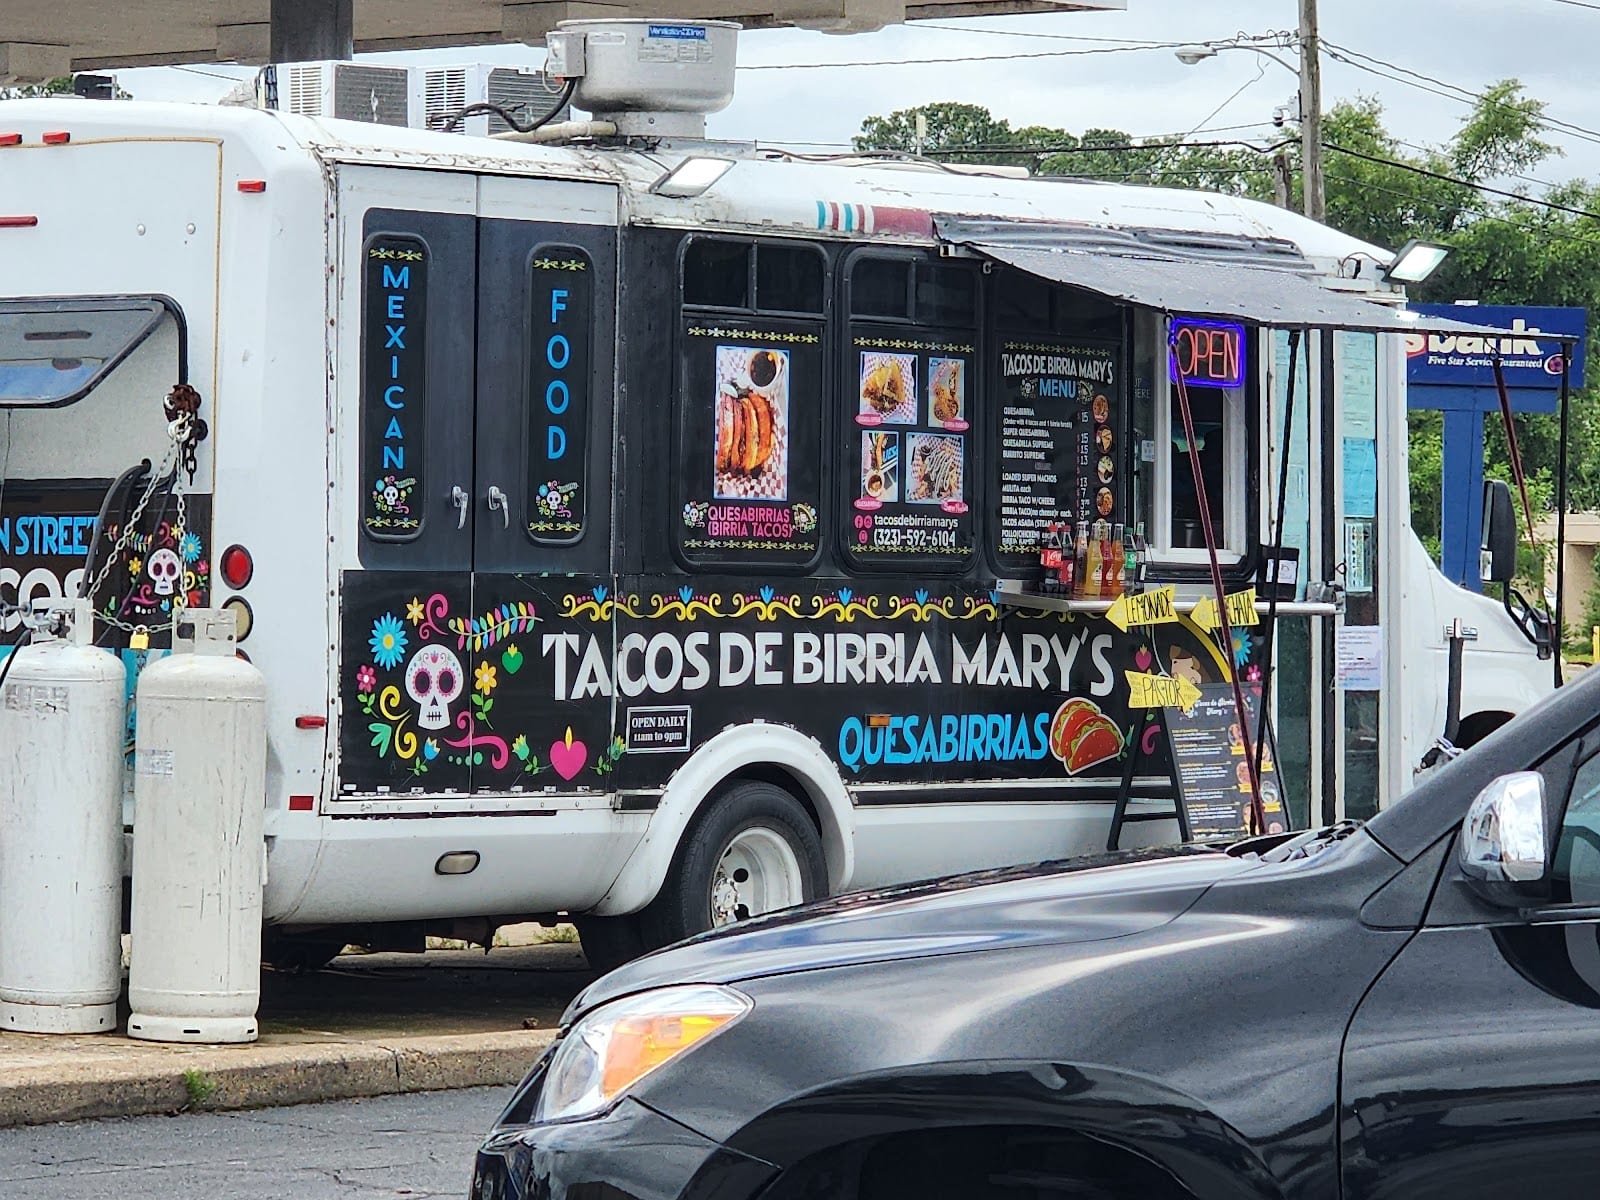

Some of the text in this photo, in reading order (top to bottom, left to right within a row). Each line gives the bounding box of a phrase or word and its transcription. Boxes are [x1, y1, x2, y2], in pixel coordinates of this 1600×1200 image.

[1177, 328, 1239, 379] OPEN
[1428, 356, 1446, 365] Five
[1447, 356, 1465, 366] Star
[382, 264, 409, 470] MEXICAN
[545, 289, 570, 460] FOOD
[1002, 354, 1113, 384] TACOS DE BIRRIA MARY'S
[1040, 378, 1076, 398] MENU
[1003, 439, 1031, 448] QUESADILLA
[1002, 473, 1057, 483] LOADED SUPER NACHOS
[1018, 496, 1031, 504] TACO
[708, 505, 790, 523] QUESABIRRIAS
[874, 514, 959, 530] tacosdebirriamarys
[1002, 518, 1017, 526] TACOS
[708, 521, 793, 538] (BIRRIA TACOS)
[874, 528, 956, 547] (323)-592-6104
[1126, 589, 1173, 624] LEMONADE
[1212, 592, 1256, 625] HCHATA
[542, 626, 1115, 701] TACOS DE BIRRIA MARY'S
[1142, 676, 1186, 707] PASTOR
[632, 716, 686, 728] OPEN DAILY
[634, 732, 682, 743] 11am to 9pm
[838, 712, 1049, 774] QUESABIRRIAS
